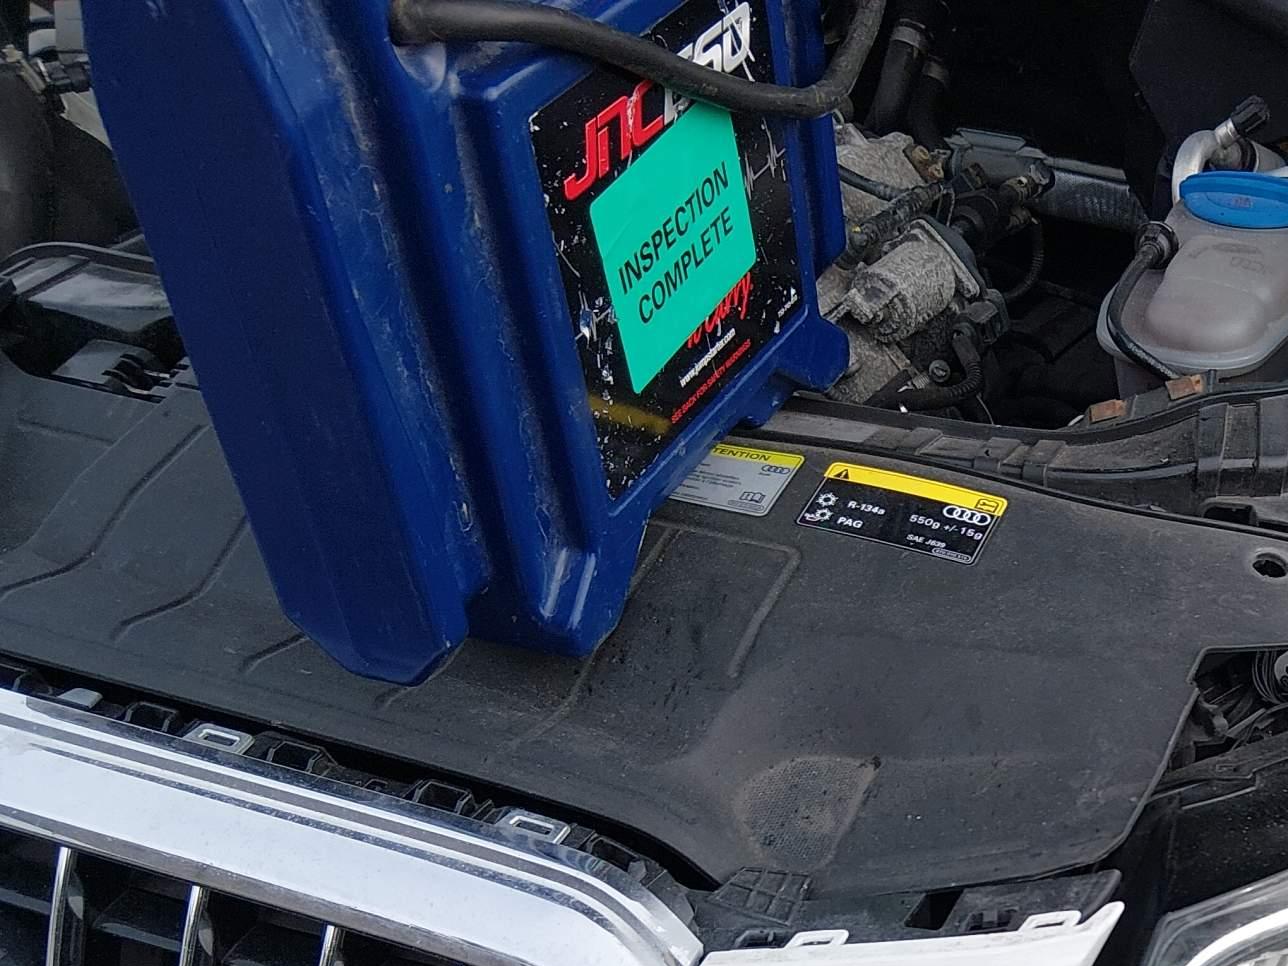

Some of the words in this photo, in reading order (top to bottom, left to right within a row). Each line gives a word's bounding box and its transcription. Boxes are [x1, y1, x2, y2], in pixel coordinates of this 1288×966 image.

[618, 161, 729, 295] INSPECTION
[638, 206, 734, 324] COMPLETE
[713, 446, 771, 462] TENTION
[847, 501, 886, 516] R-134a
[837, 516, 864, 529] PAG
[909, 514, 941, 530] 550g
[906, 534, 925, 543] SAE
